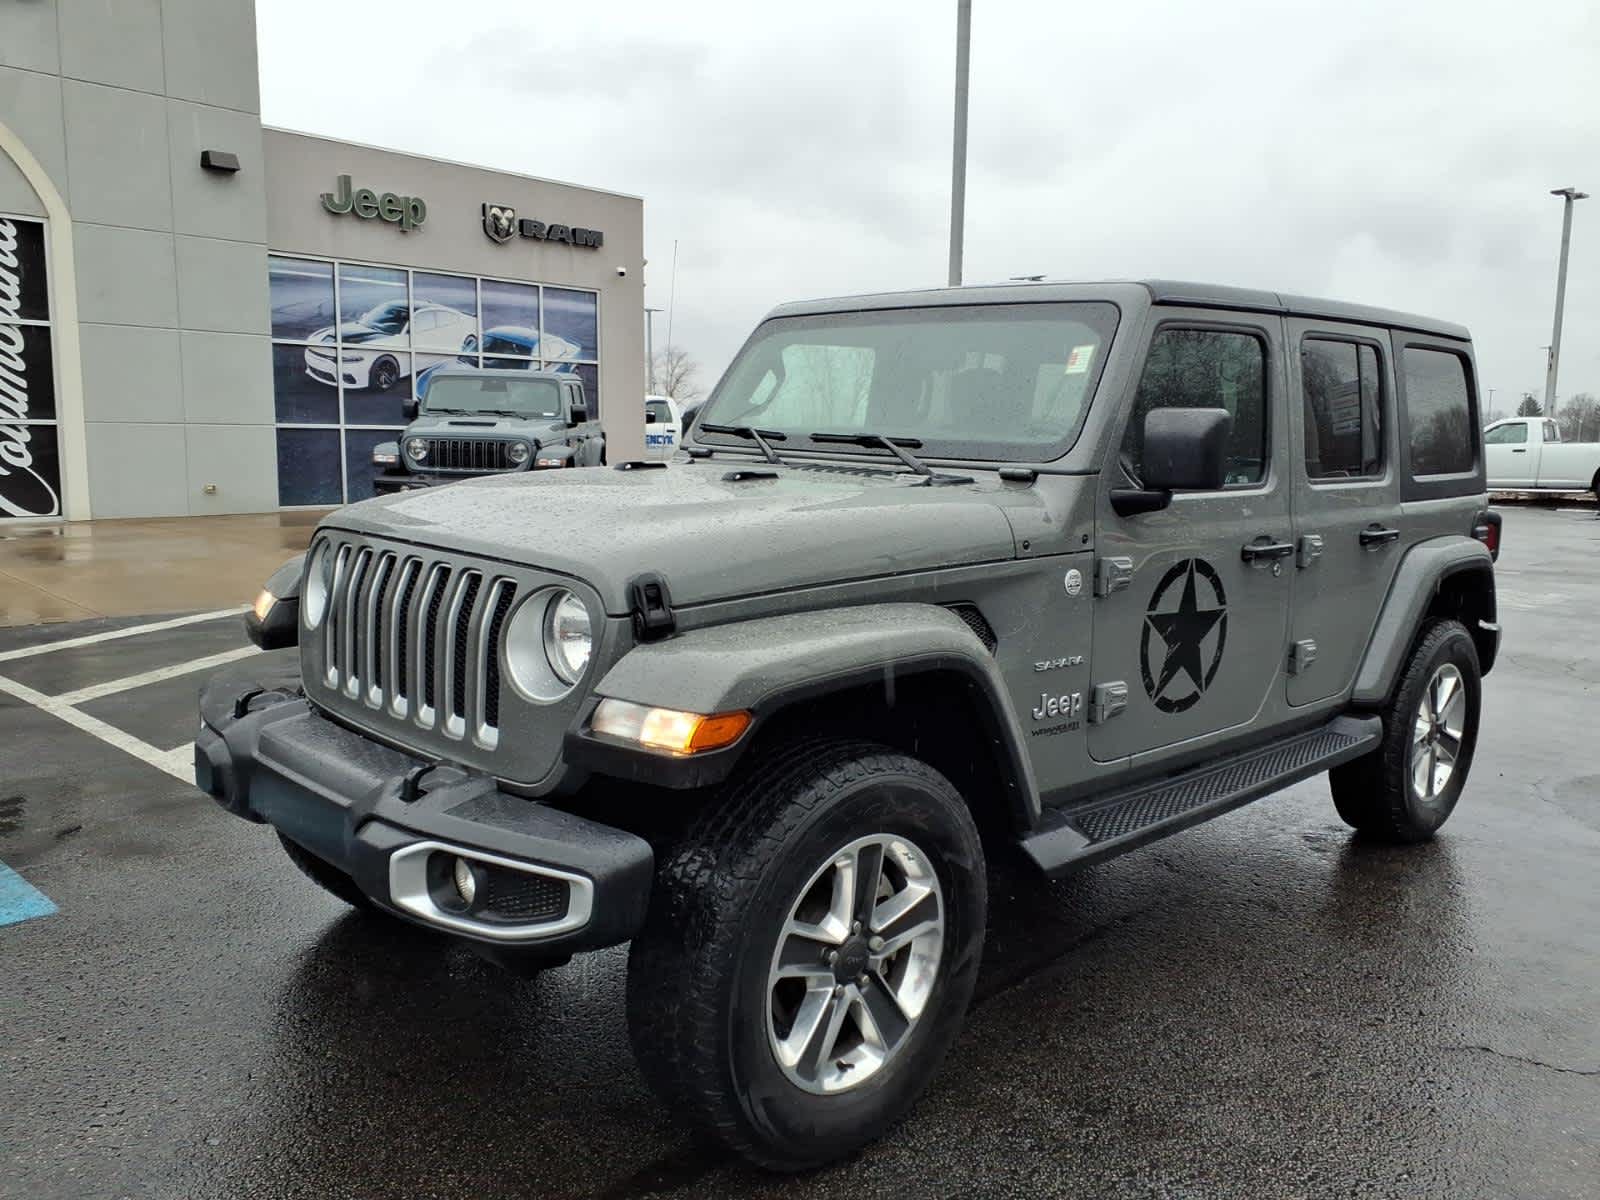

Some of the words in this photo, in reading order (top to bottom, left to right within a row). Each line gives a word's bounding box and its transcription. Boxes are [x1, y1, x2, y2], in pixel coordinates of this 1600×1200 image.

[320, 174, 427, 232] Jeep
[518, 218, 604, 248] RAM
[1032, 692, 1083, 721] Jeep
